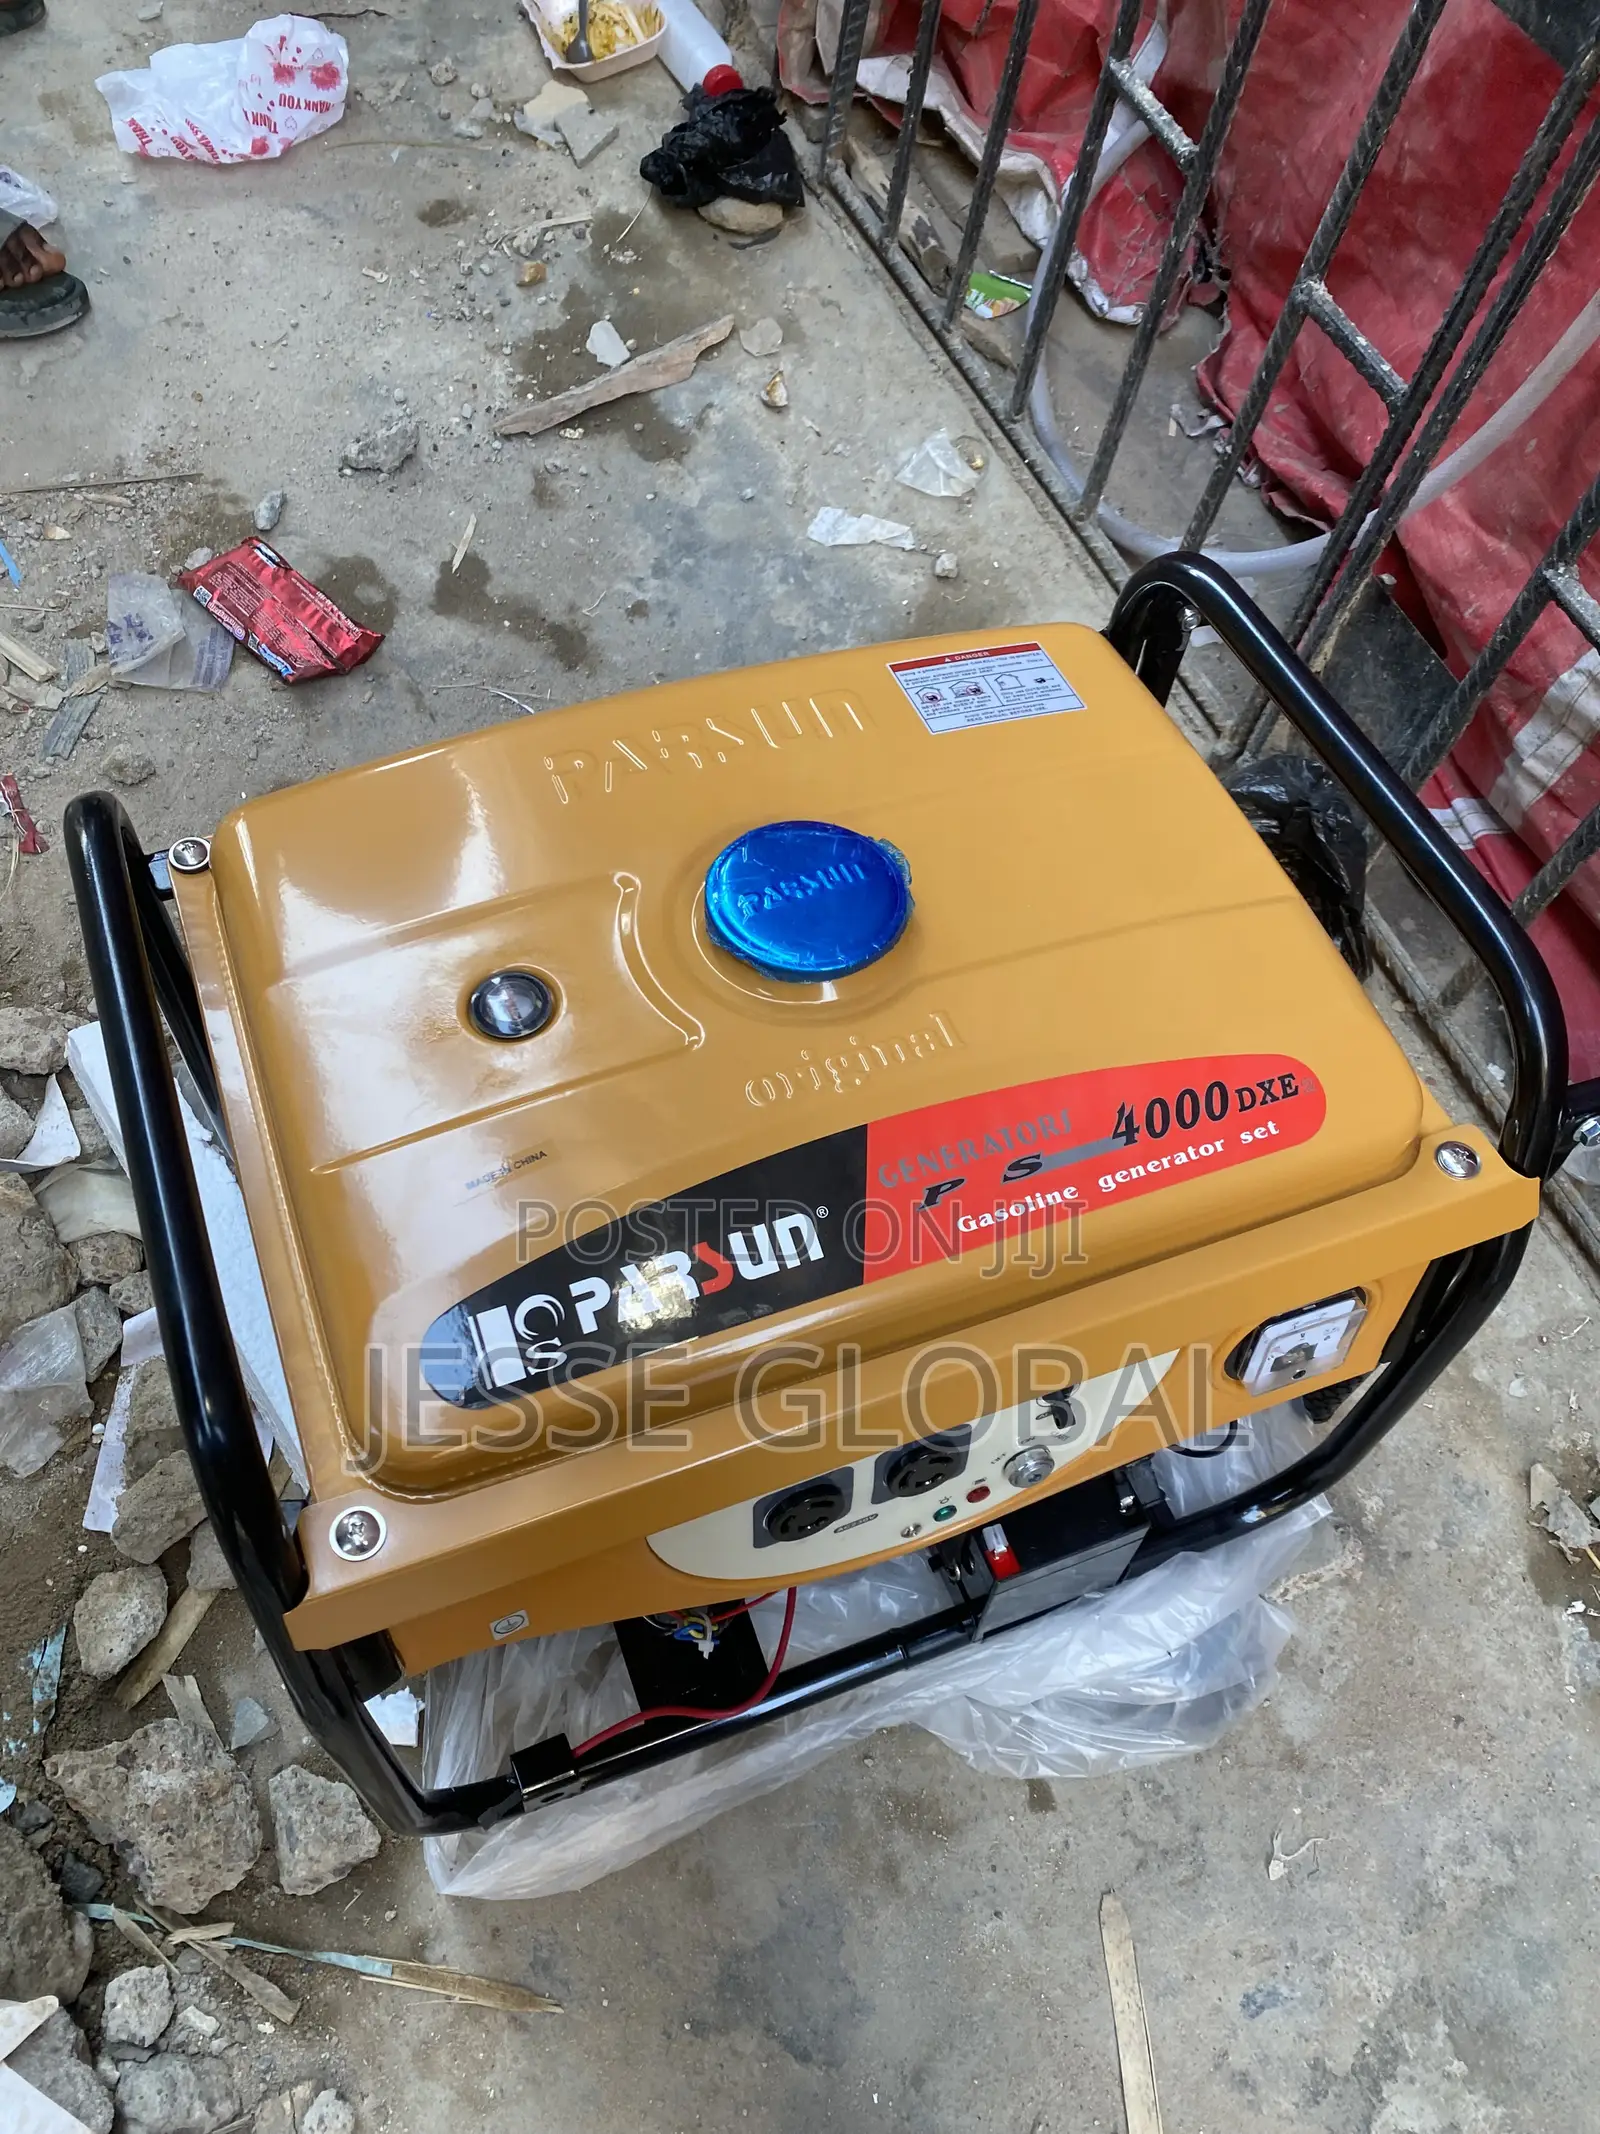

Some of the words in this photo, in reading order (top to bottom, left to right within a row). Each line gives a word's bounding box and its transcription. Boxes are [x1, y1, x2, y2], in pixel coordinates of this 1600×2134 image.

[279, 93, 301, 109] YOU
[953, 650, 991, 661] DANGER
[513, 1149, 548, 1170] CHINA
[957, 1183, 1079, 1234] Gasoline
[1098, 1137, 1225, 1193] generator
[1240, 1119, 1280, 1146] set
[917, 1177, 967, 1212] P
[1000, 1153, 1044, 1184] S
[569, 1212, 824, 1335] PARSUN
